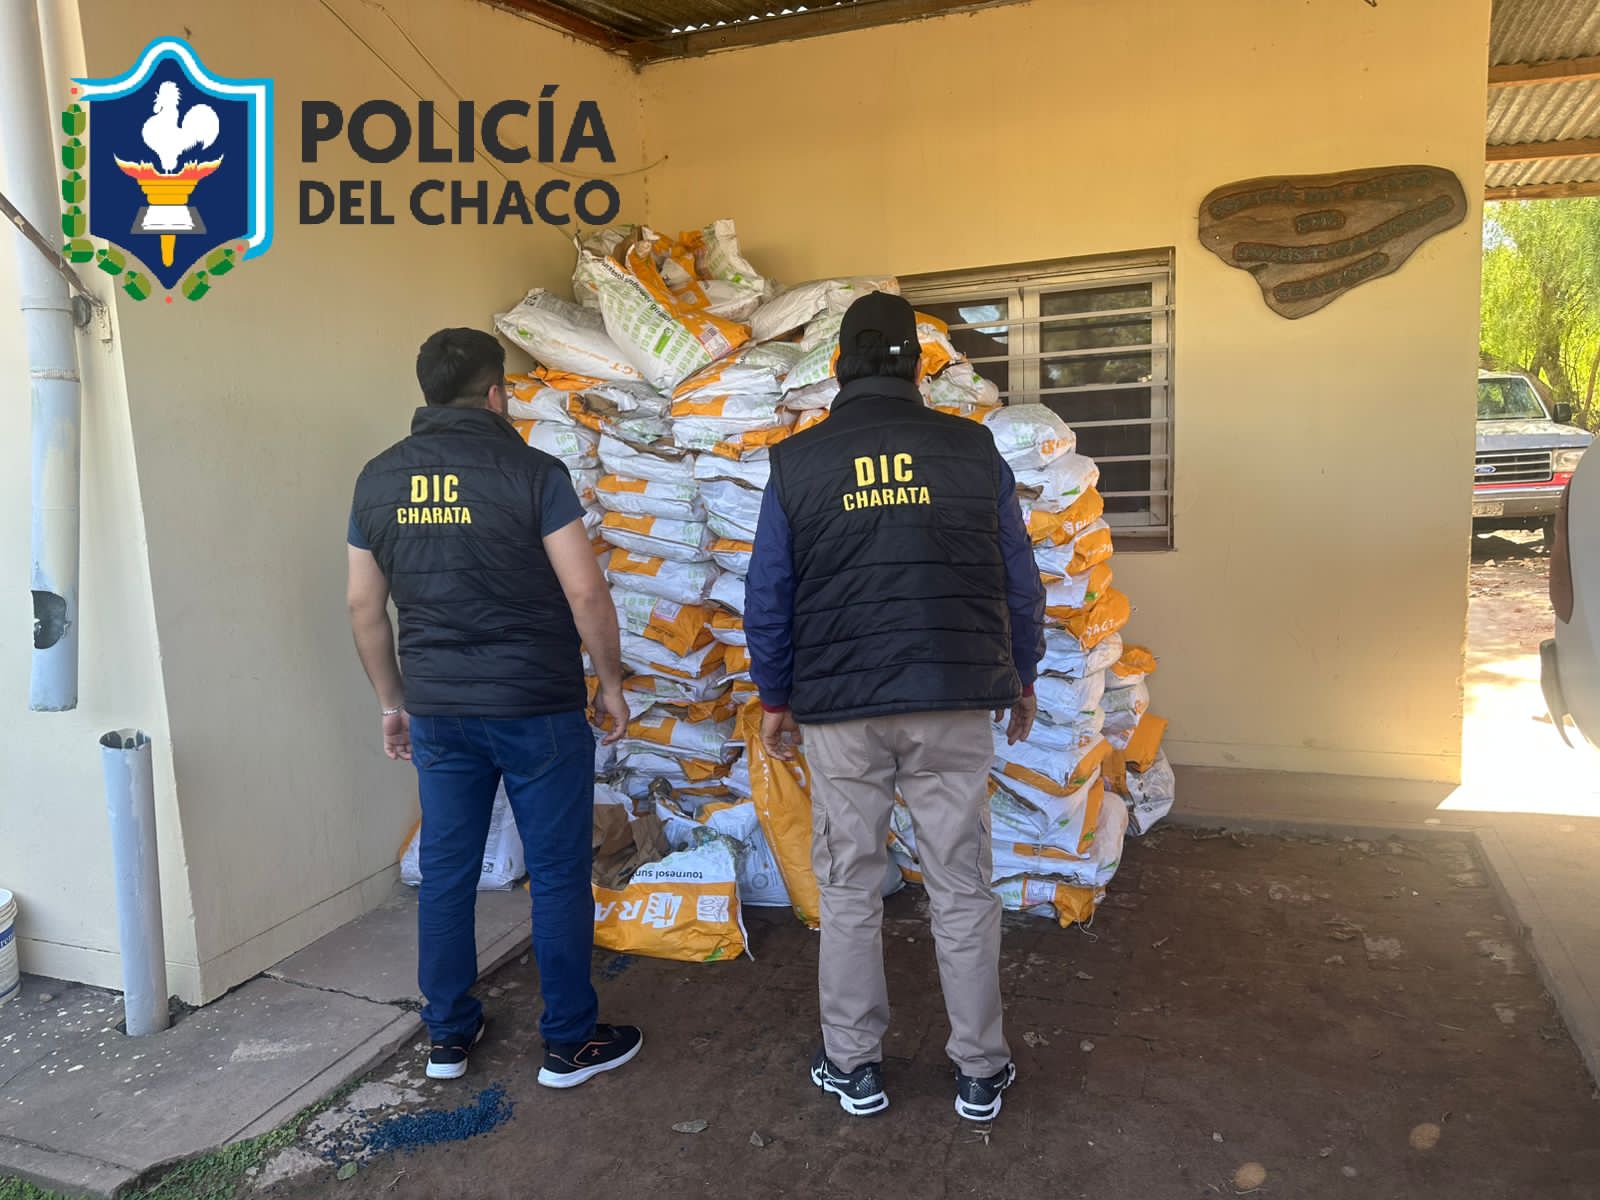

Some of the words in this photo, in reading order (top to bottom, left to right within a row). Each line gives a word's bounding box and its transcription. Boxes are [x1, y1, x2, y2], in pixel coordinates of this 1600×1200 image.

[854, 452, 913, 487] DIC
[410, 474, 459, 503] DIC
[842, 486, 931, 512] CHARATA
[396, 506, 472, 525] CHARATA
[656, 870, 703, 880] tournesol
